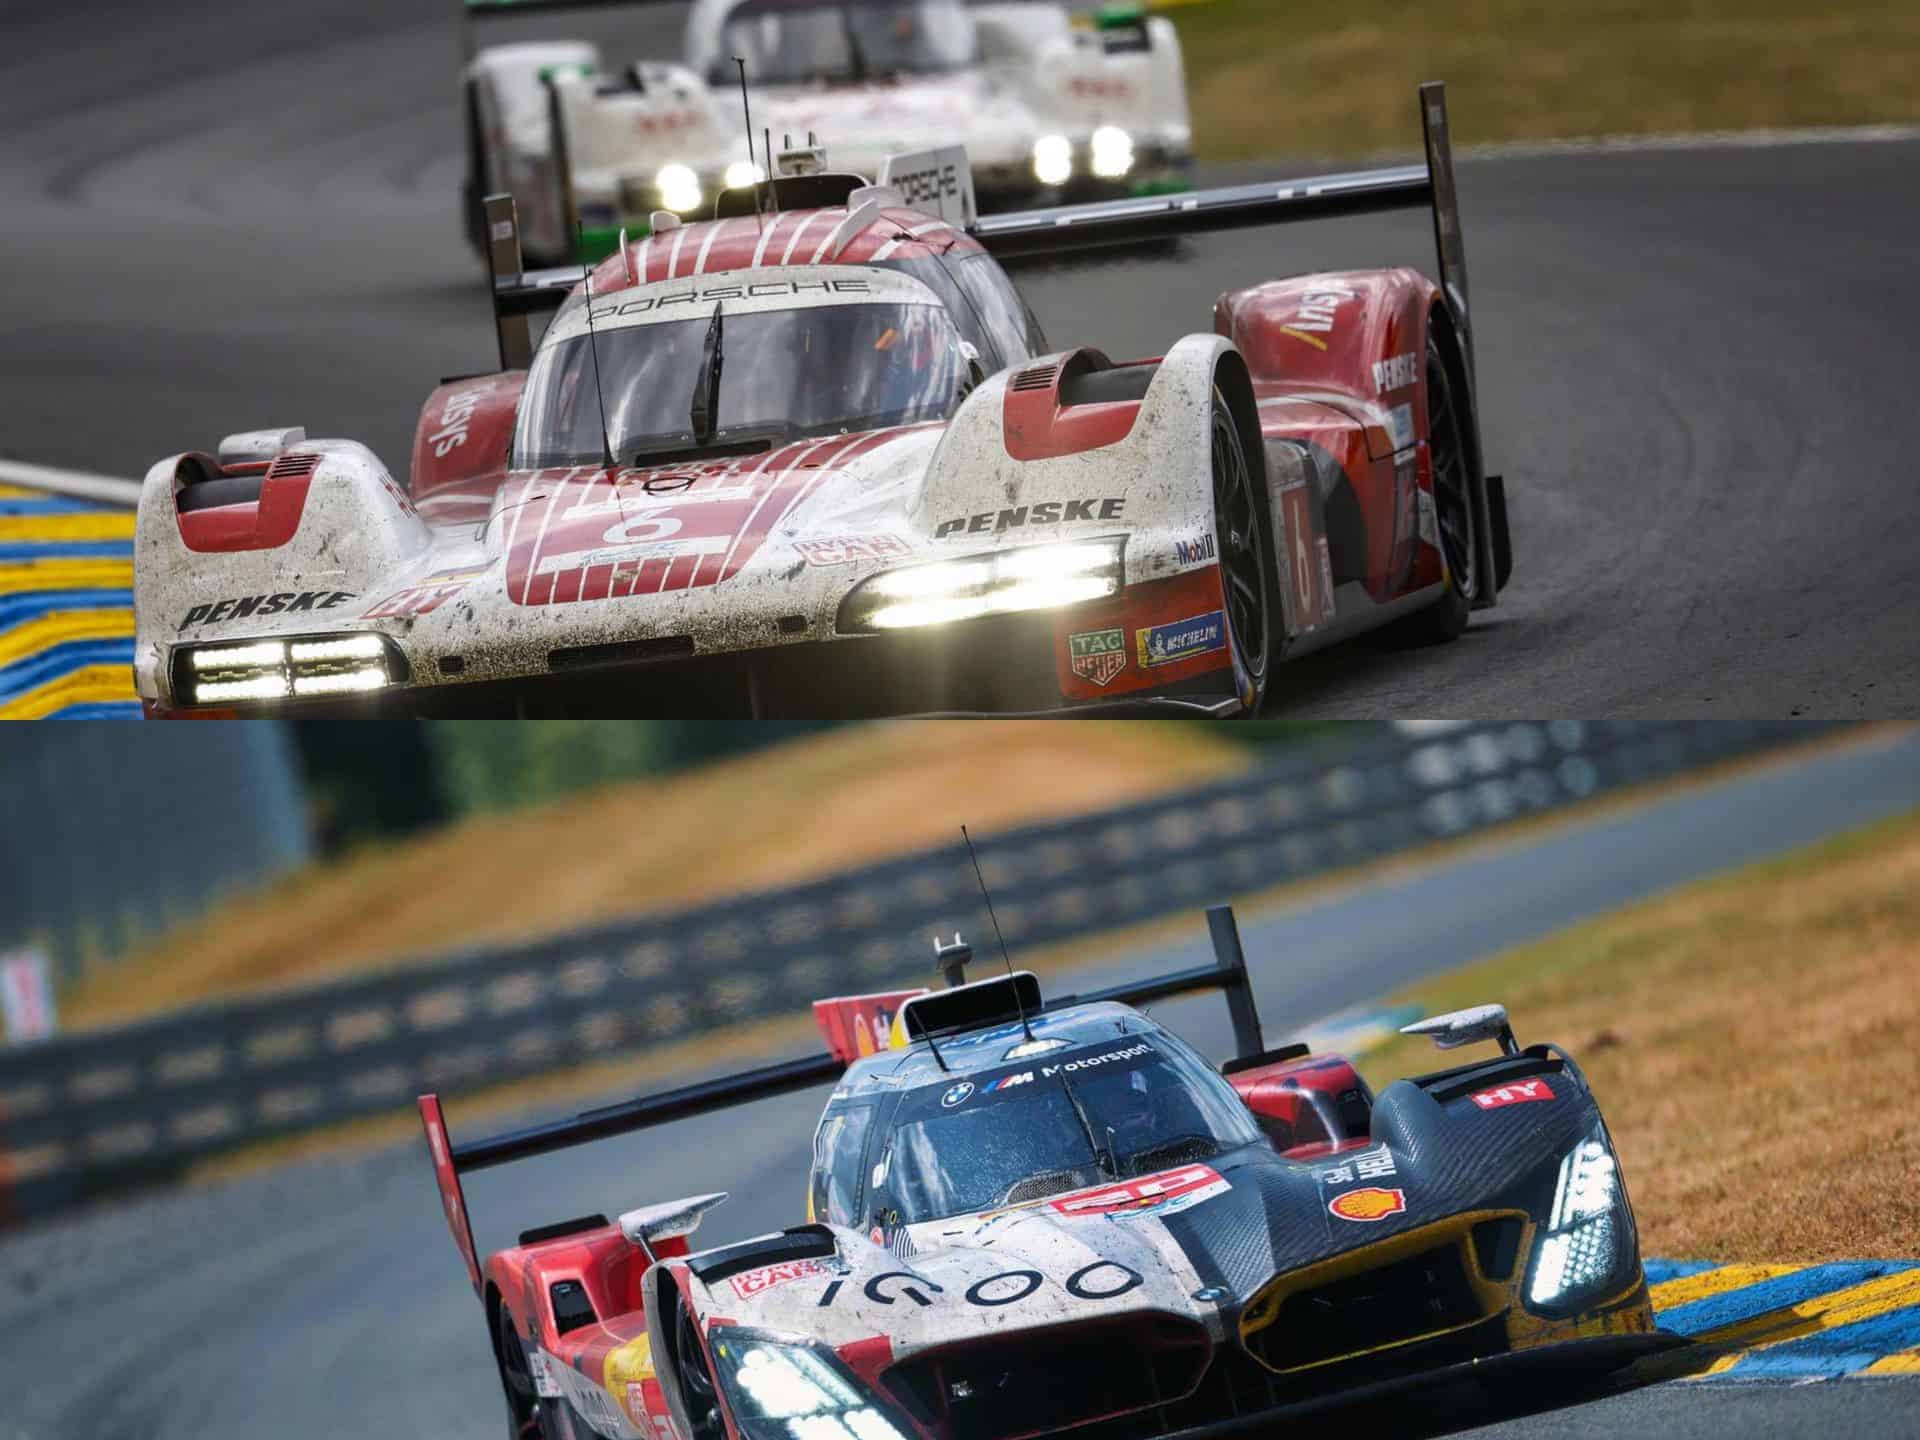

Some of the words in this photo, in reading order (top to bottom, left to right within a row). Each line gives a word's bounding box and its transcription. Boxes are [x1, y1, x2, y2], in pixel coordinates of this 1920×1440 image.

[586, 279, 870, 322] PORSCHE
[603, 506, 682, 544] 6
[934, 498, 1127, 538] PENSKE
[178, 591, 359, 632] PENSKE
[1077, 632, 1121, 652] TAG
[1166, 624, 1218, 651] MICHELIN
[1041, 1041, 1154, 1078] Motorsport
